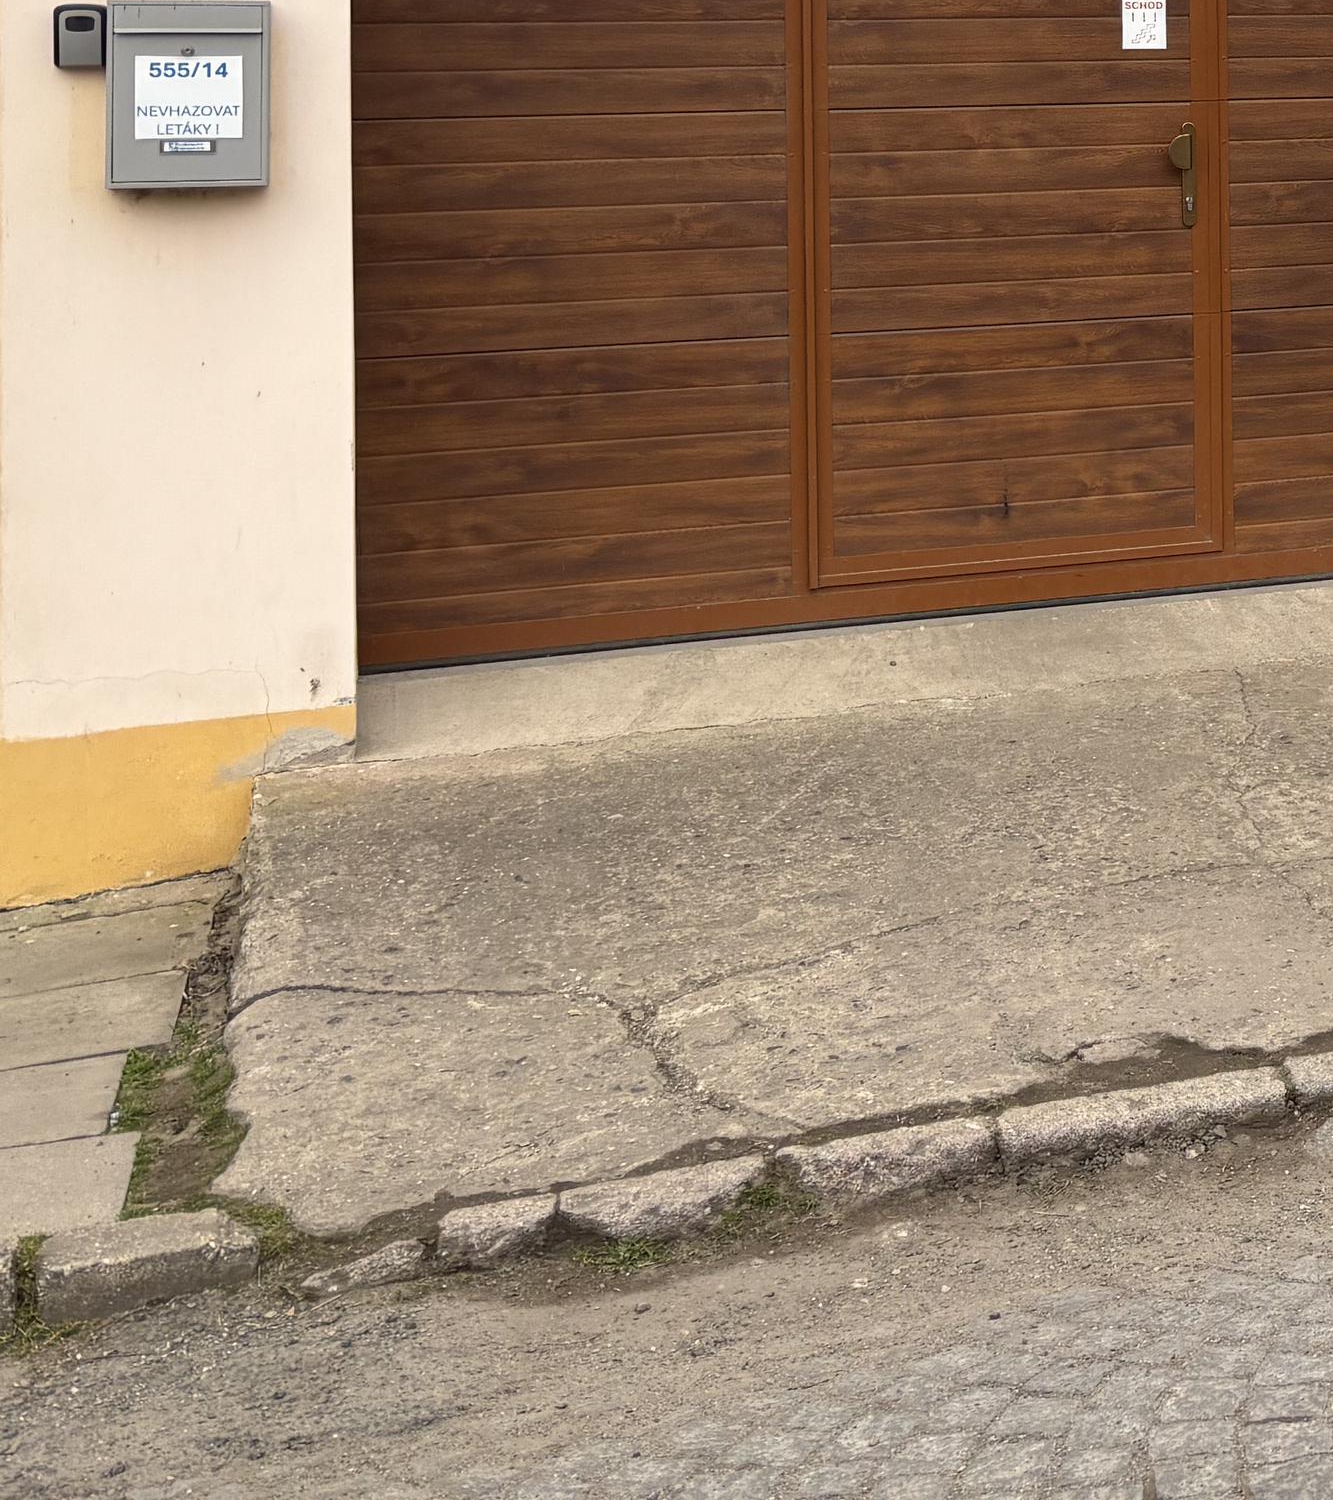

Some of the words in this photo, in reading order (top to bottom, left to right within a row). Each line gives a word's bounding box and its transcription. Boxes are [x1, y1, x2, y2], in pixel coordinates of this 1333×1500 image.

[1125, 1, 1163, 10] SCHOD
[149, 61, 228, 78] 555/14
[136, 105, 240, 117] NEVHAZOVAT
[156, 120, 211, 135] LETÁKY
